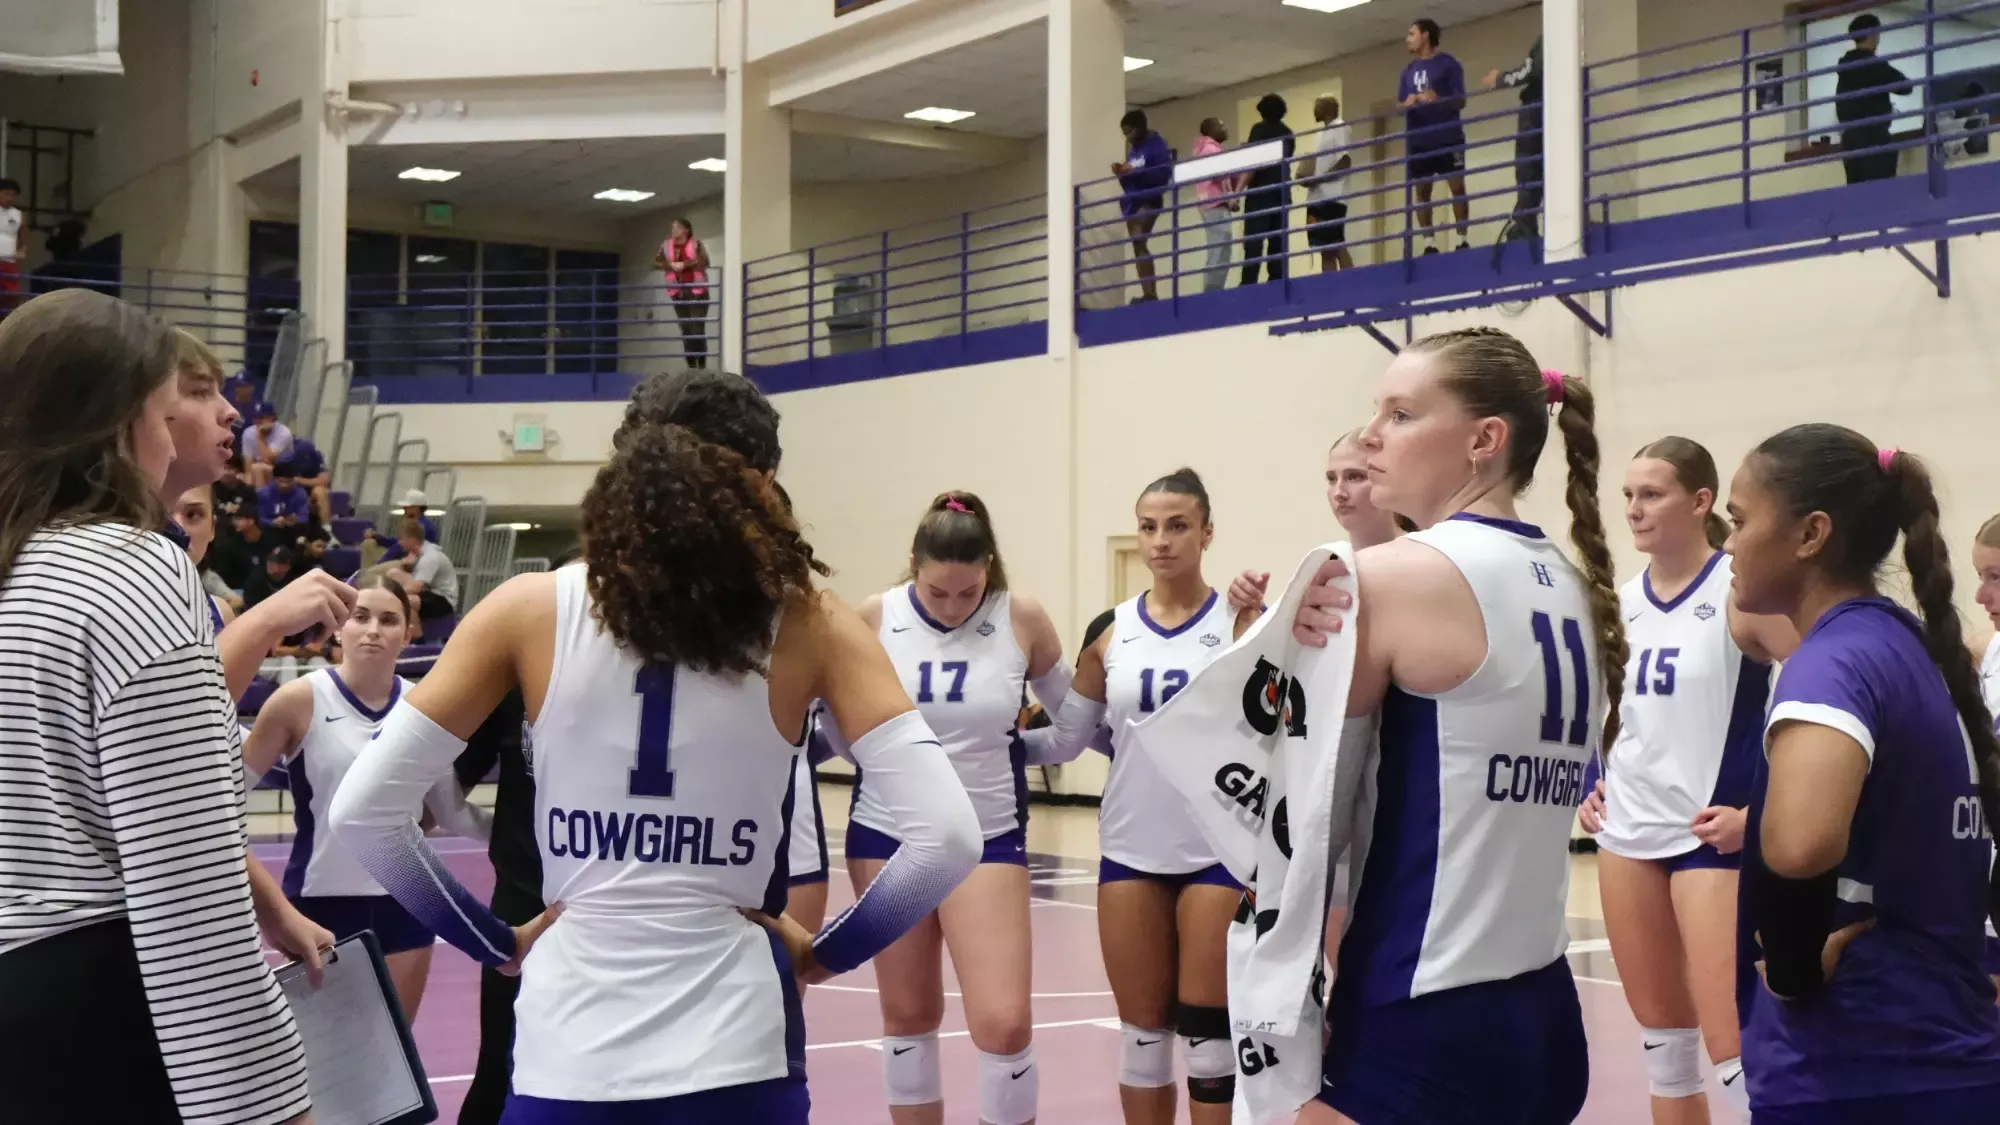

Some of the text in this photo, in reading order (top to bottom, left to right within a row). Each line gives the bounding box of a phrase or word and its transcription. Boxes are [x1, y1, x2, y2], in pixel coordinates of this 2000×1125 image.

[917, 660, 969, 703] 17
[1139, 667, 1191, 713] 12
[1531, 608, 1589, 748] 11
[1635, 647, 1681, 696] 15
[626, 660, 677, 801] 1
[548, 806, 759, 867] COWGIRLS
